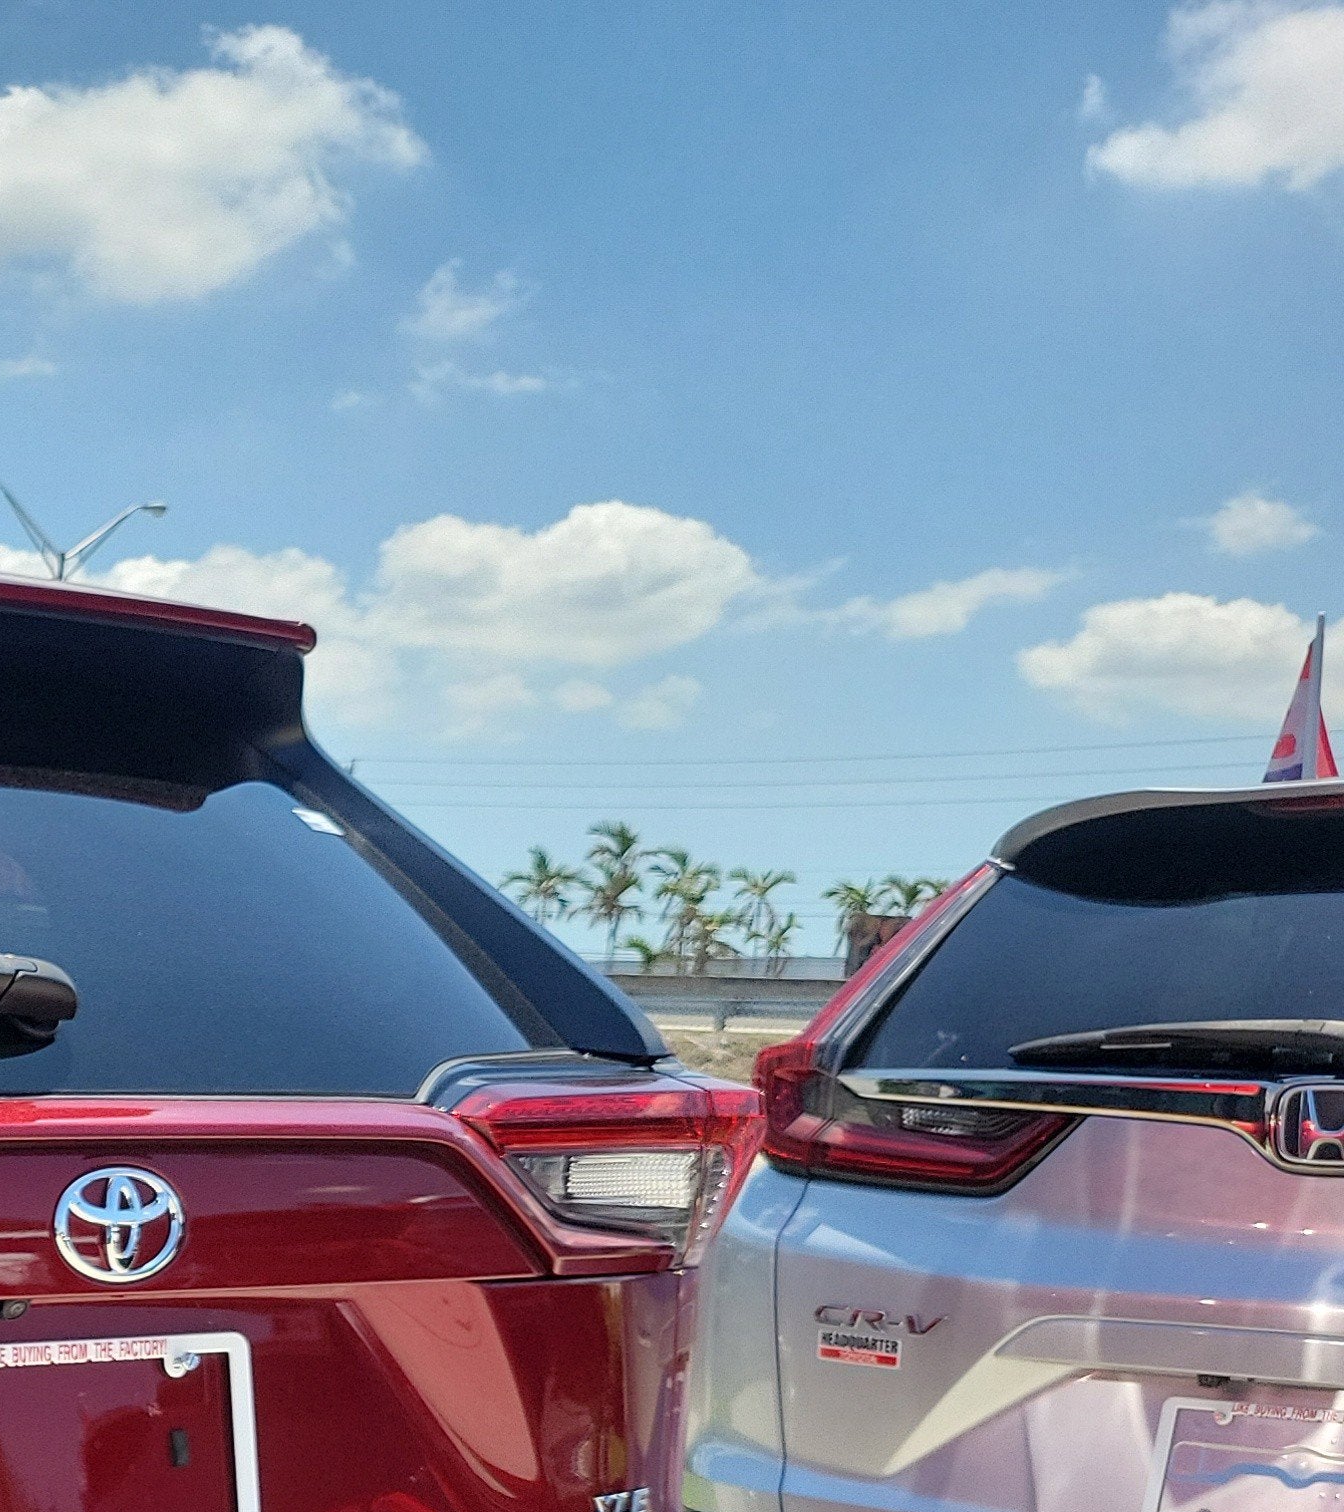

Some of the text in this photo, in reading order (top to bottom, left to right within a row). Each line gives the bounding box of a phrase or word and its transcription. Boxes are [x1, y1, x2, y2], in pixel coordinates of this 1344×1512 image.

[814, 1304, 949, 1335] CR-V
[12, 1345, 51, 1363] BUYING
[57, 1343, 88, 1361] FROM
[94, 1341, 114, 1359] THE
[119, 1338, 168, 1358] FACTORY!
[821, 1331, 899, 1354] HEADQUARTER
